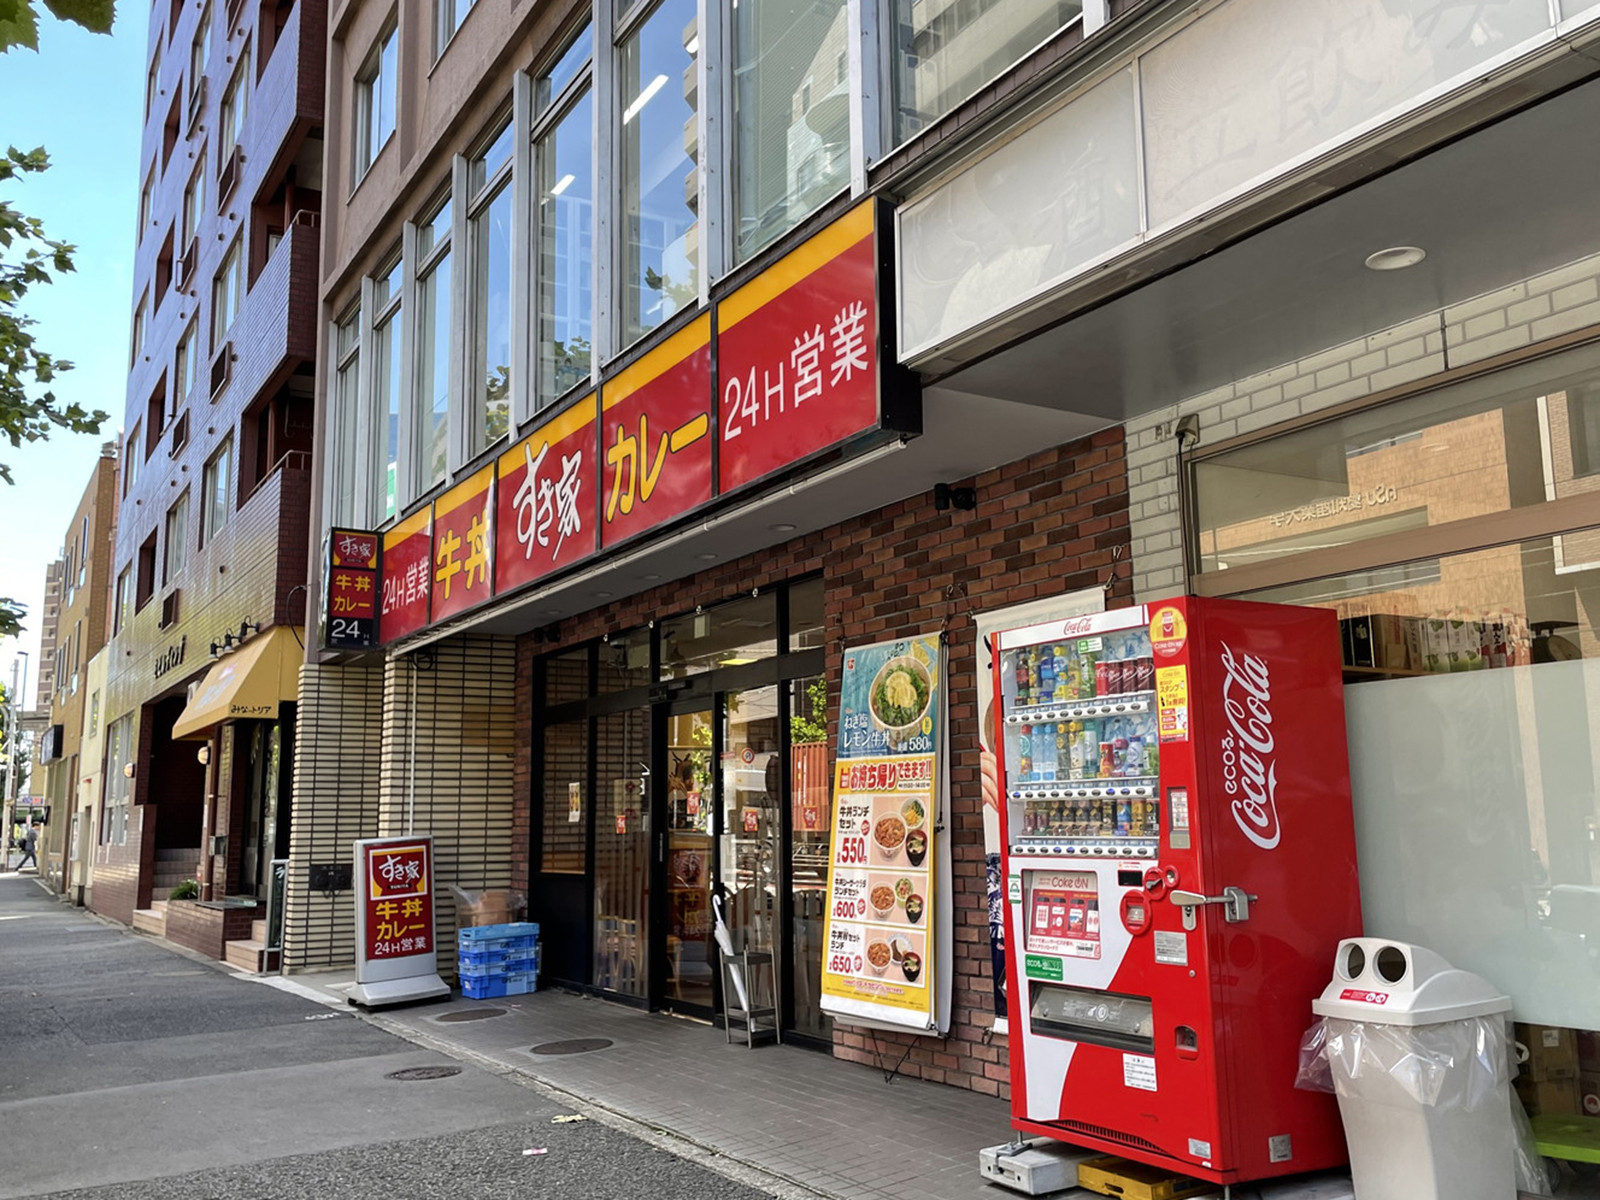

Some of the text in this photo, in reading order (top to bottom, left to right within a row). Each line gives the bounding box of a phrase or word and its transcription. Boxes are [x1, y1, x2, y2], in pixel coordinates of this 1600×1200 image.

[725, 300, 868, 441] 24H営業
[606, 413, 709, 524] カレー
[512, 441, 582, 561] すき家
[339, 536, 371, 559] すき家
[435, 509, 489, 600] 牛丼
[335, 574, 371, 592] 牛丼
[382, 556, 429, 615] 24H営業
[334, 595, 370, 612] カレー
[844, 713, 868, 729] ねぎ塩
[843, 730, 890, 748] レモン牛丼
[1220, 640, 1281, 850] Coca-Cola
[850, 763, 897, 789] お持ち帰り
[839, 806, 870, 818] 牛丼ランチ
[838, 818, 856, 830] セット
[379, 855, 419, 883] すき家
[1051, 876, 1074, 889] Coke
[376, 898, 423, 920] 牛丼
[376, 921, 425, 941] カレー
[374, 936, 426, 956] 24H営業
